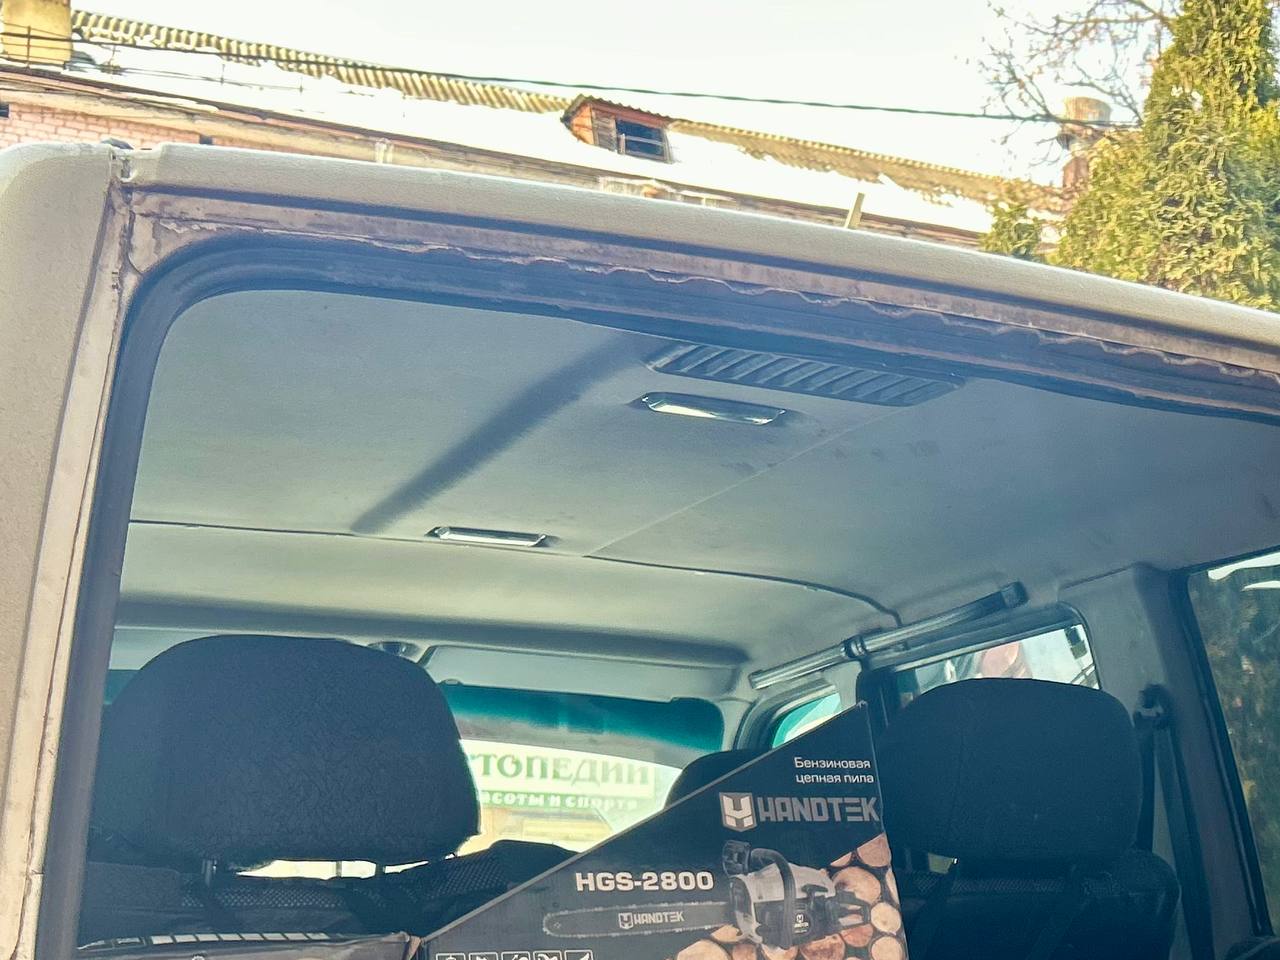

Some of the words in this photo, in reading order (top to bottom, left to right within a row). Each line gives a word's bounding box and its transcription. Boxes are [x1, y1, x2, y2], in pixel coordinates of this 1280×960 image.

[471, 753, 649, 787] ТОПЕДИИ
[794, 757, 871, 769] Бензиновая
[796, 774, 842, 784] цепная
[844, 774, 874, 783] пила
[757, 796, 880, 823] HANDTEK
[575, 871, 715, 892] HGS-2800
